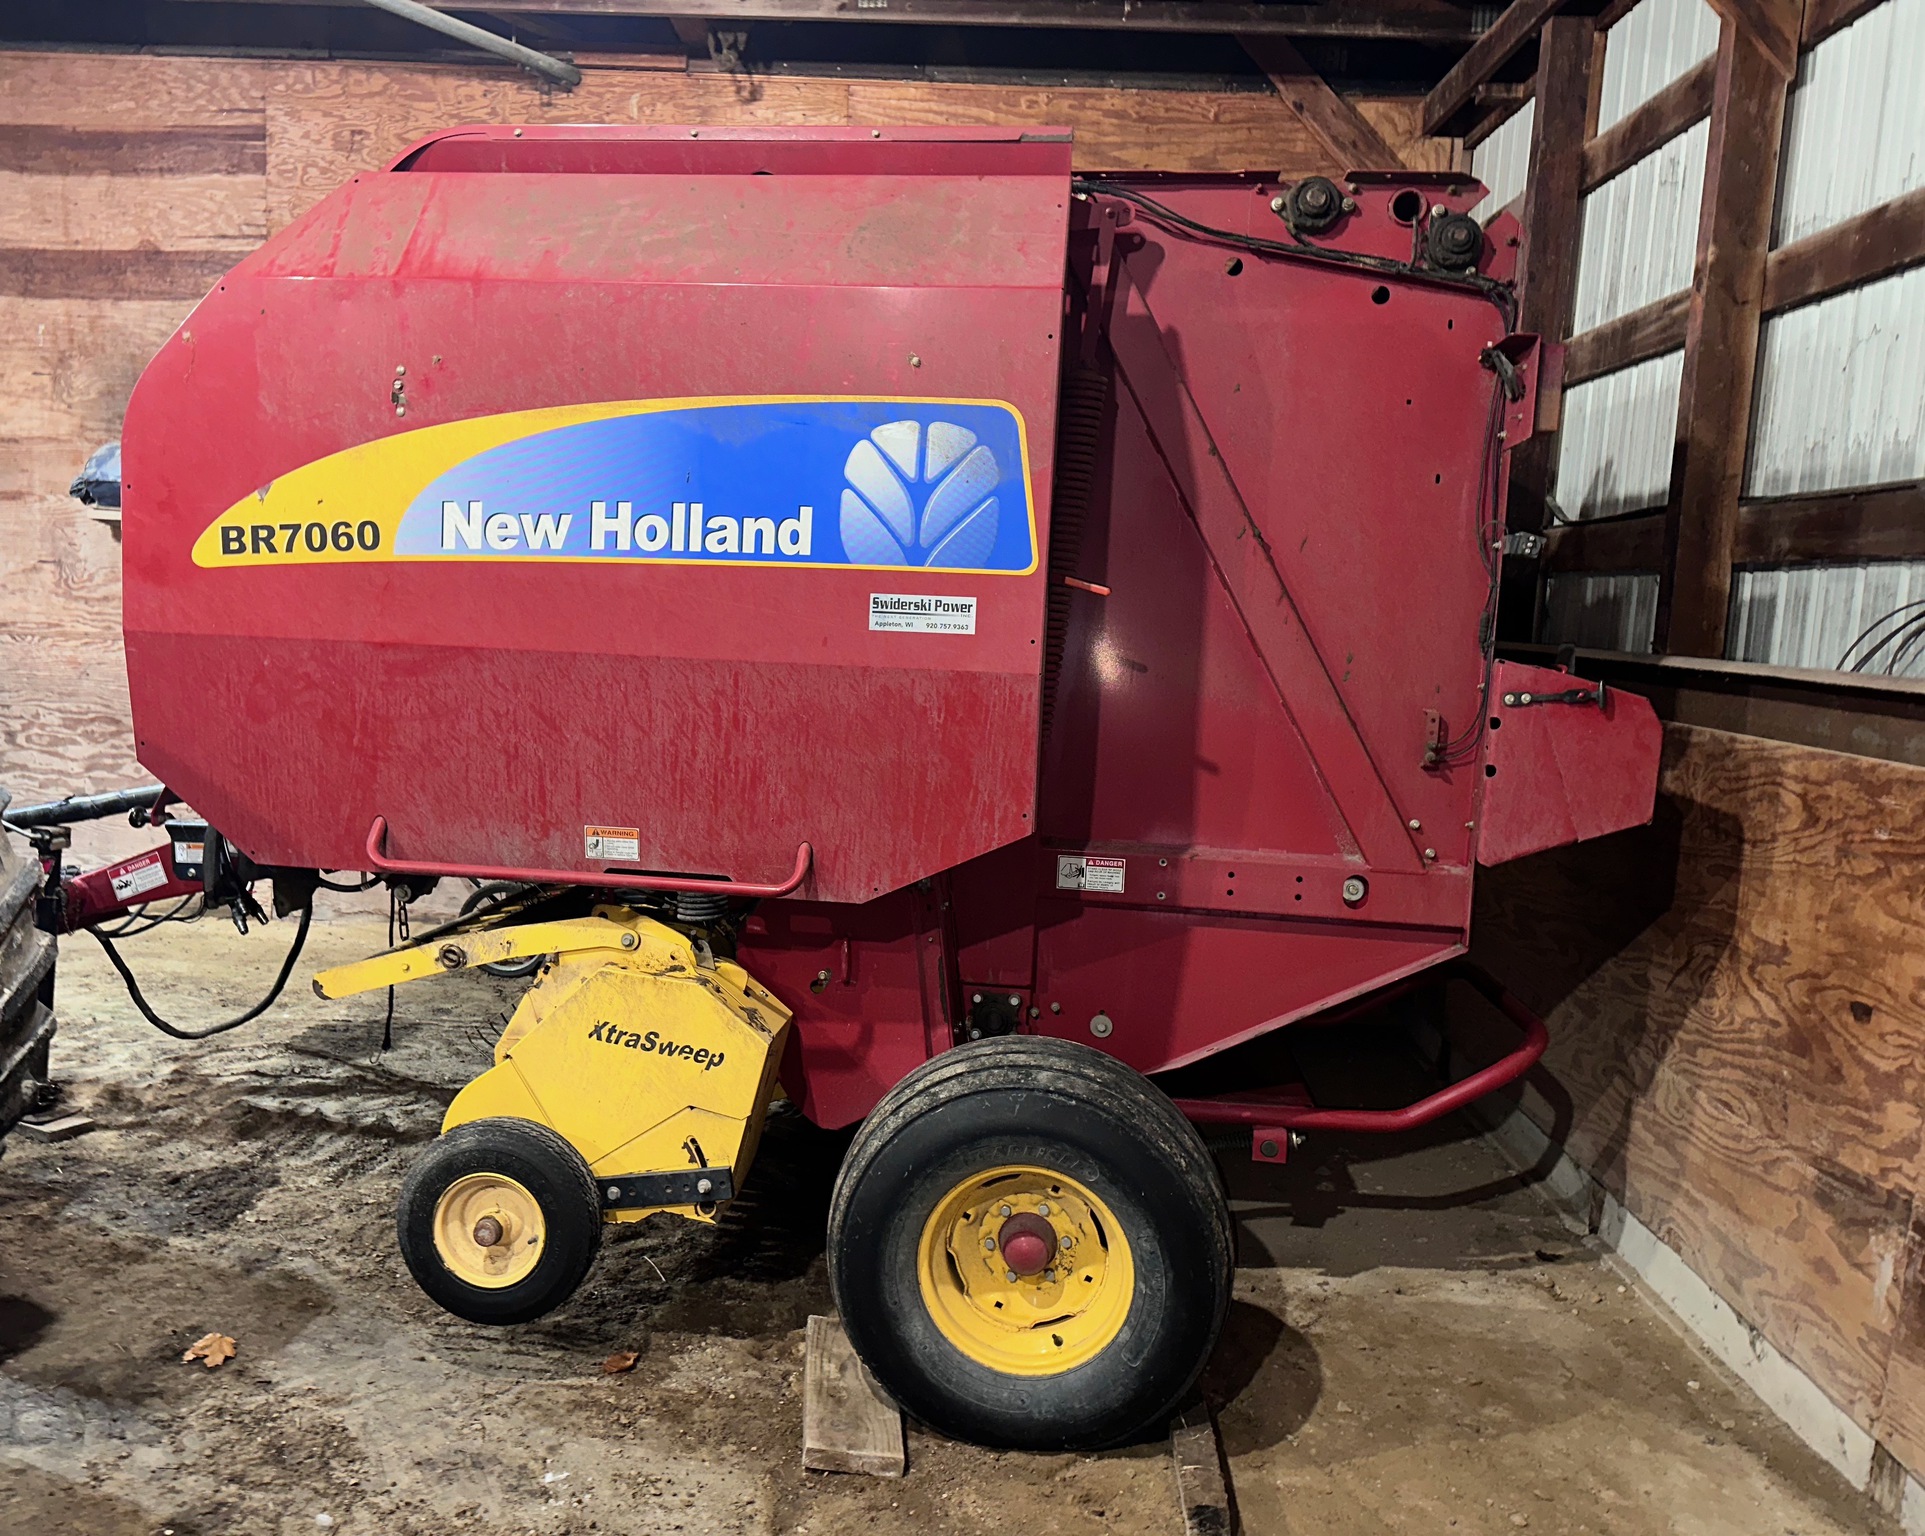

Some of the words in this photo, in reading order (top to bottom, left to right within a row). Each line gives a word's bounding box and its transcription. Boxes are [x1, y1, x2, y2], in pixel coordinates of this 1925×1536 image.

[220, 521, 381, 555] BR7060
[440, 500, 573, 552] New
[590, 502, 813, 557] Holland
[872, 597, 931, 611] Swiderski
[934, 599, 973, 613] Power
[127, 858, 151, 872] DANGER
[588, 1020, 725, 1072] XtraSweep
